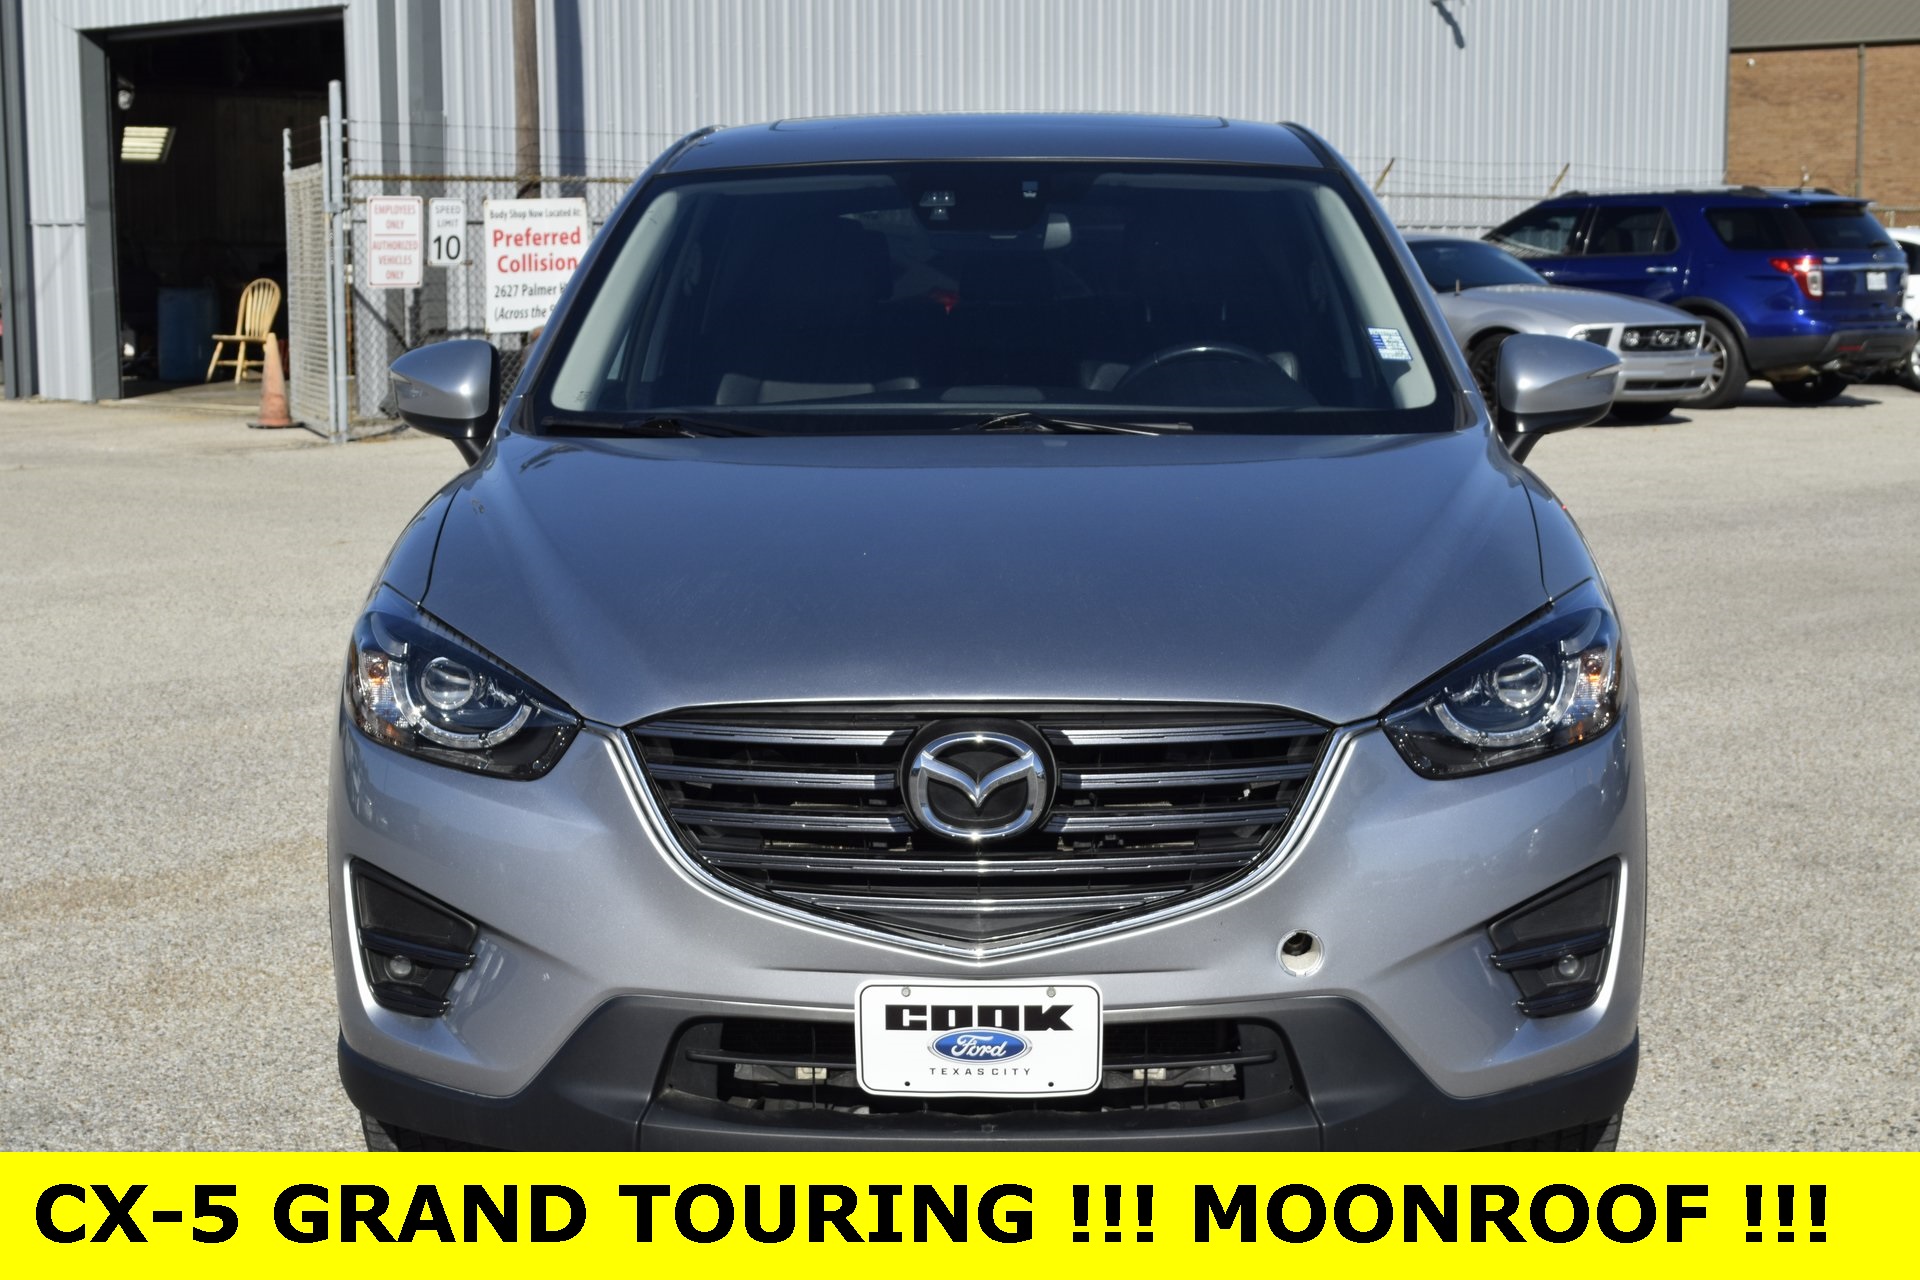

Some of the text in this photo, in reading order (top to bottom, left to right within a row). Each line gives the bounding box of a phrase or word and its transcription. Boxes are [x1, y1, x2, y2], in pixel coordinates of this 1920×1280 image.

[374, 203, 416, 215] EMPLOYEES
[435, 204, 461, 215] SPEED
[490, 208, 507, 220] Body
[509, 208, 527, 220] Shop
[528, 208, 543, 217] Now
[545, 207, 571, 217] Located
[385, 219, 404, 230] ONLY
[437, 218, 459, 229] LIMIT
[493, 225, 581, 247] Preferred
[372, 240, 418, 250] AUTHORIZED
[433, 235, 461, 260] 10
[378, 255, 412, 265] VEHICLES
[497, 252, 578, 273] Collision
[385, 270, 404, 280] ONLY
[494, 284, 519, 298] 2627
[521, 282, 557, 297] Palmer
[494, 305, 529, 322] (Across
[531, 304, 547, 318] the
[885, 1004, 1074, 1032] COOK
[951, 1034, 1008, 1057] Ford
